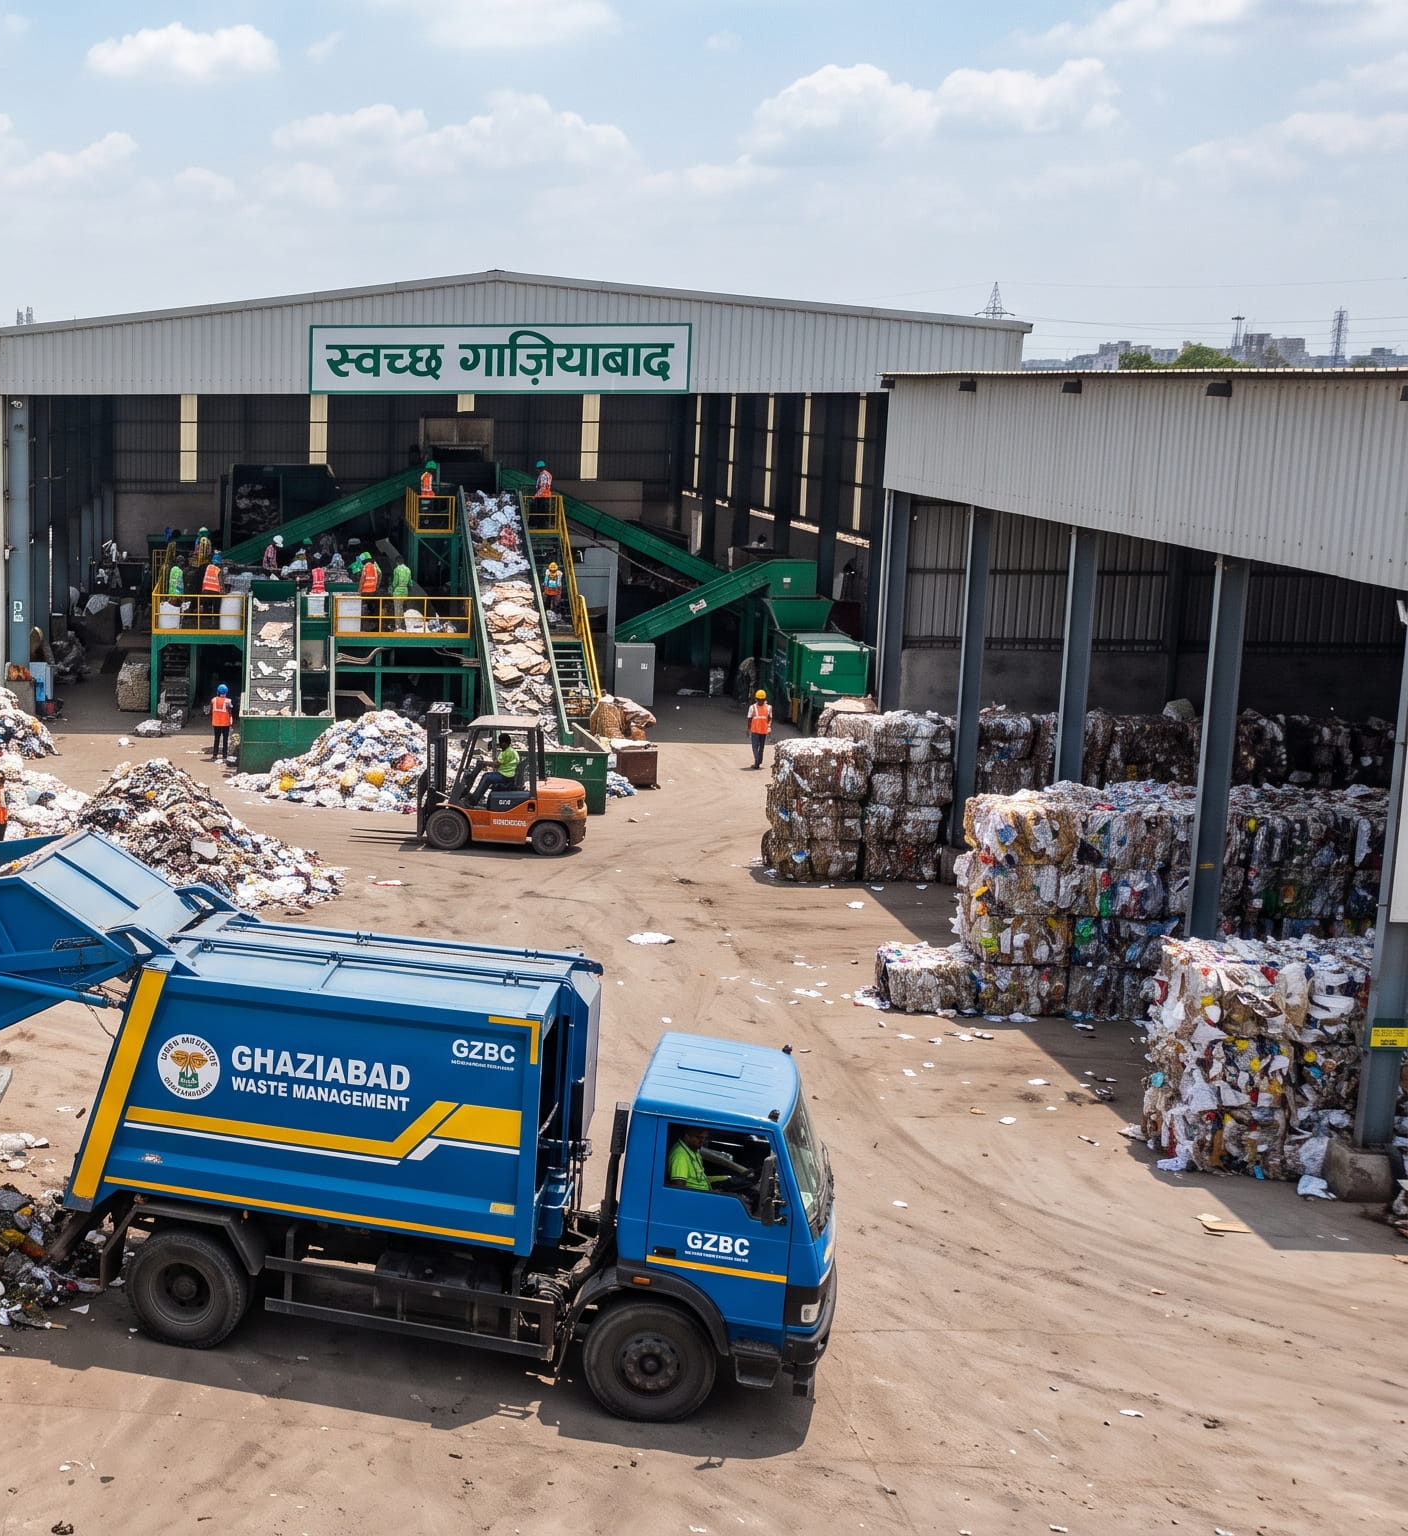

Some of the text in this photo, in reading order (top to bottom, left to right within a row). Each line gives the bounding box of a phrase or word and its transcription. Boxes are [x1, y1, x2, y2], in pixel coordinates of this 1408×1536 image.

[326, 330, 675, 386] स्वच्छ गाज़ियाबाद
[231, 1045, 410, 1091] GHAZIABAD
[452, 1039, 516, 1064] GZBC
[231, 1077, 288, 1098] WASTE
[292, 1084, 410, 1112] MANAGEMENT
[687, 1231, 750, 1256] GZBC
